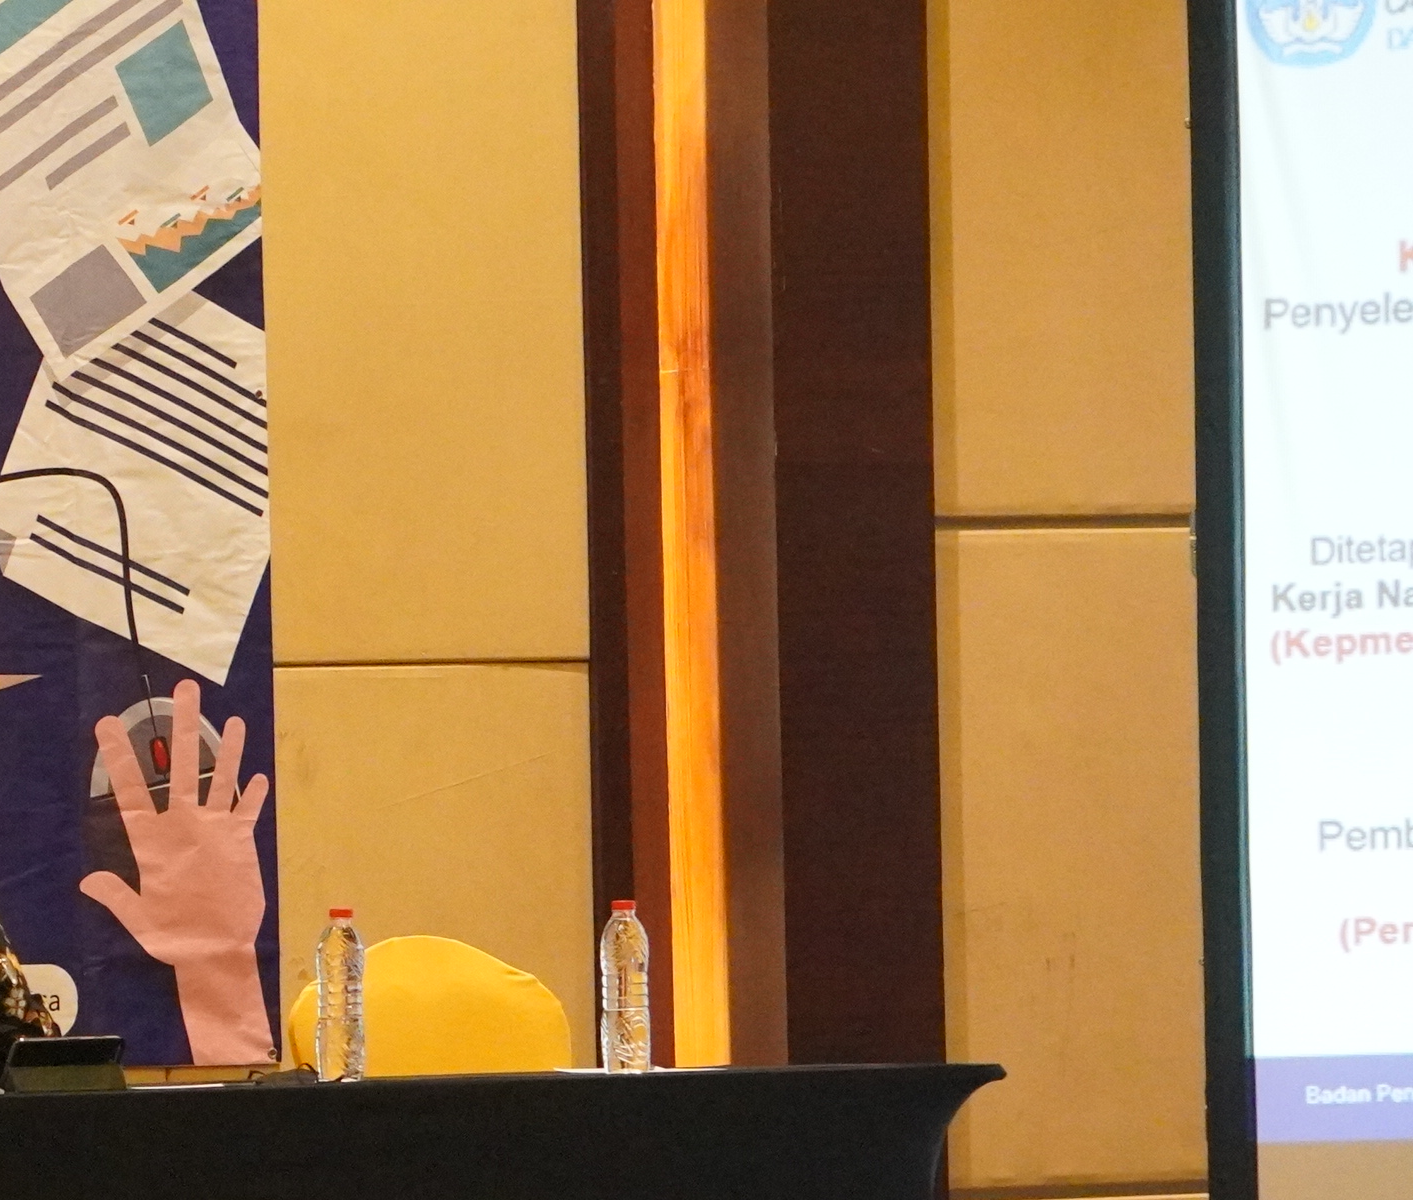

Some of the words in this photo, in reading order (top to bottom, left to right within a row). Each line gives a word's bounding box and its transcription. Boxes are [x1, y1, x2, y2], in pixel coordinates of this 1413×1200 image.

[1310, 535, 1413, 568] Diteta
[1272, 580, 1364, 619] Kerja
[1305, 1085, 1372, 1104] Badan
